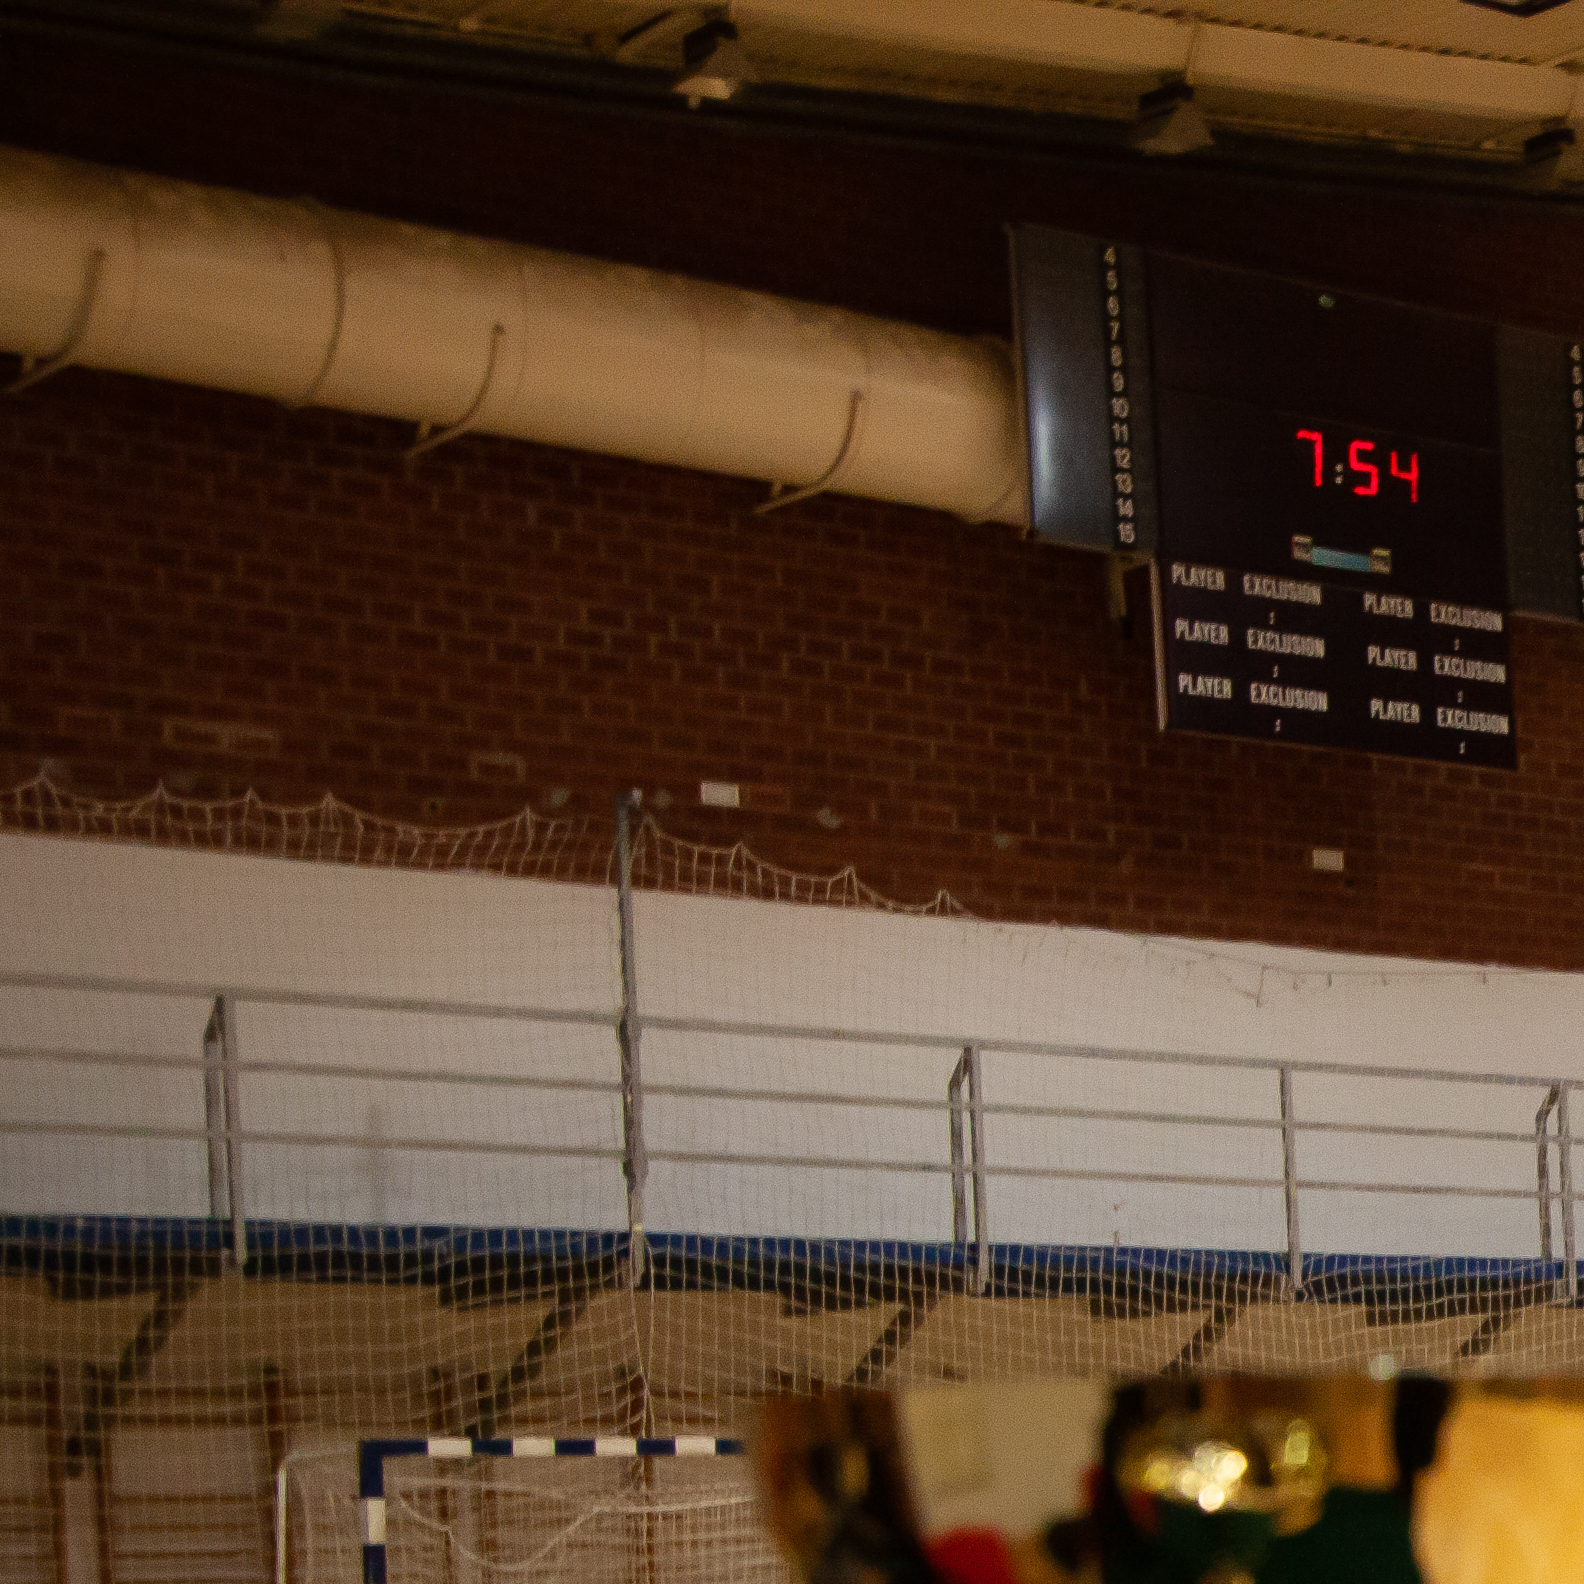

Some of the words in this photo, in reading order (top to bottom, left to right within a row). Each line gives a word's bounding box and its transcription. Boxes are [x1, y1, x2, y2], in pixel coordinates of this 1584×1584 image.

[1104, 247, 1115, 264] 4
[1107, 270, 1117, 290] 5
[1107, 296, 1119, 316] 6
[1110, 321, 1119, 339] 7
[1111, 346, 1122, 366] 8
[1112, 371, 1124, 392] 9
[1111, 398, 1129, 418] 10
[1112, 423, 1128, 441] 11
[1114, 448, 1130, 468] 12
[1296, 429, 1419, 503] 7:54
[1115, 473, 1133, 493] 13
[1117, 498, 1134, 517] 14
[1118, 523, 1135, 543] 15
[1172, 563, 1225, 590] PLAYER
[1243, 574, 1321, 605] EXCLUSION
[1364, 592, 1413, 618] PLAYER
[1430, 602, 1503, 631] EXCLUSION
[1175, 618, 1228, 644] PLAYER
[1247, 628, 1325, 658] EXCLUSION
[1368, 645, 1417, 670] PLAYER
[1434, 655, 1506, 683] EXCLUSION
[1178, 673, 1231, 698] PLAYER
[1250, 682, 1328, 711] EXCLUSION
[1371, 698, 1420, 723] PLAYER
[1437, 707, 1509, 734] EXCLUSION
